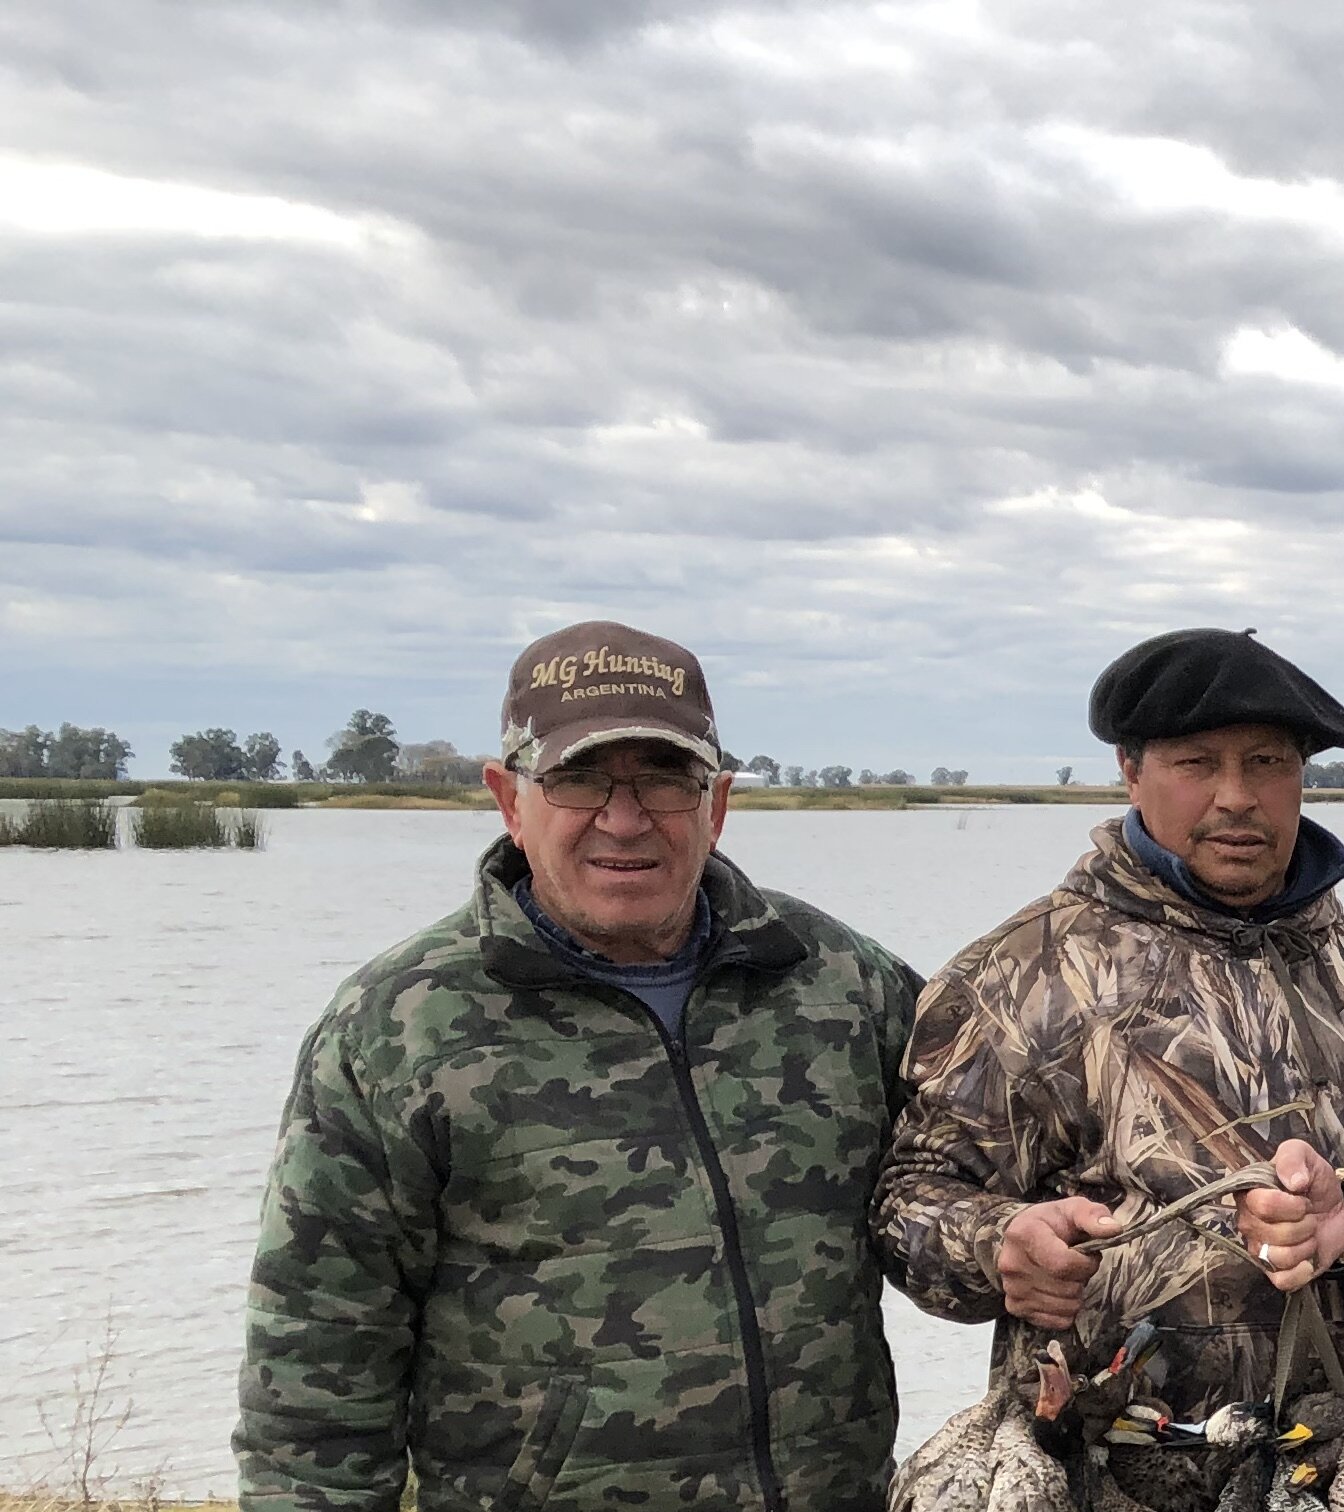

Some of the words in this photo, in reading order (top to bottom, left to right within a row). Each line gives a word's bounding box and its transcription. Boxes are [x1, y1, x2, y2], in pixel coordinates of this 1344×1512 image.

[530, 654, 577, 689] MG
[583, 646, 685, 695] Hunting
[561, 683, 667, 703] ARGENTINA
